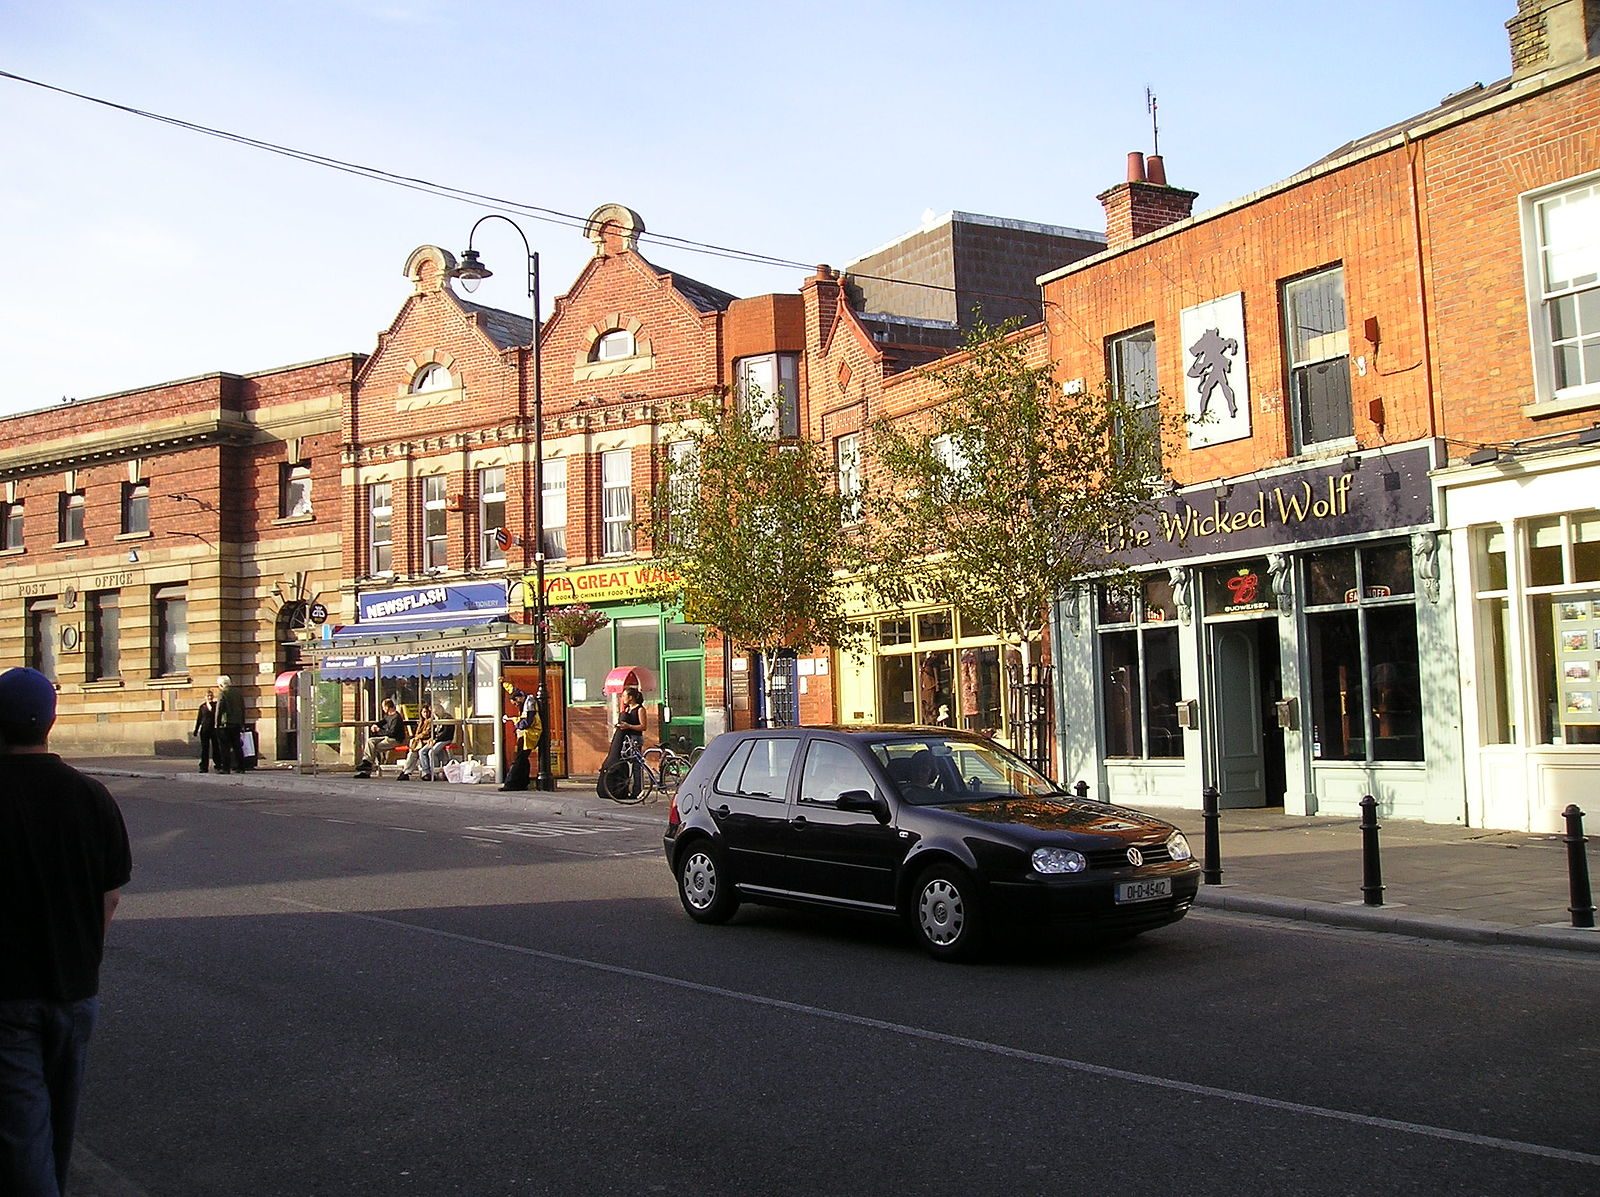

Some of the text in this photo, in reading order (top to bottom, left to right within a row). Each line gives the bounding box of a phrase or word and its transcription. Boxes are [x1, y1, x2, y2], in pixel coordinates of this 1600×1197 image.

[1161, 491, 1267, 542] Wicked
[1275, 474, 1354, 525] Wolf
[19, 573, 133, 596] POST OFFICE
[543, 577, 571, 592] THE
[577, 572, 629, 590] GREAT
[366, 587, 448, 619] NEWSFLASH
[580, 591, 605, 599] CHINESE
[1224, 602, 1269, 613] BUDWEISER
